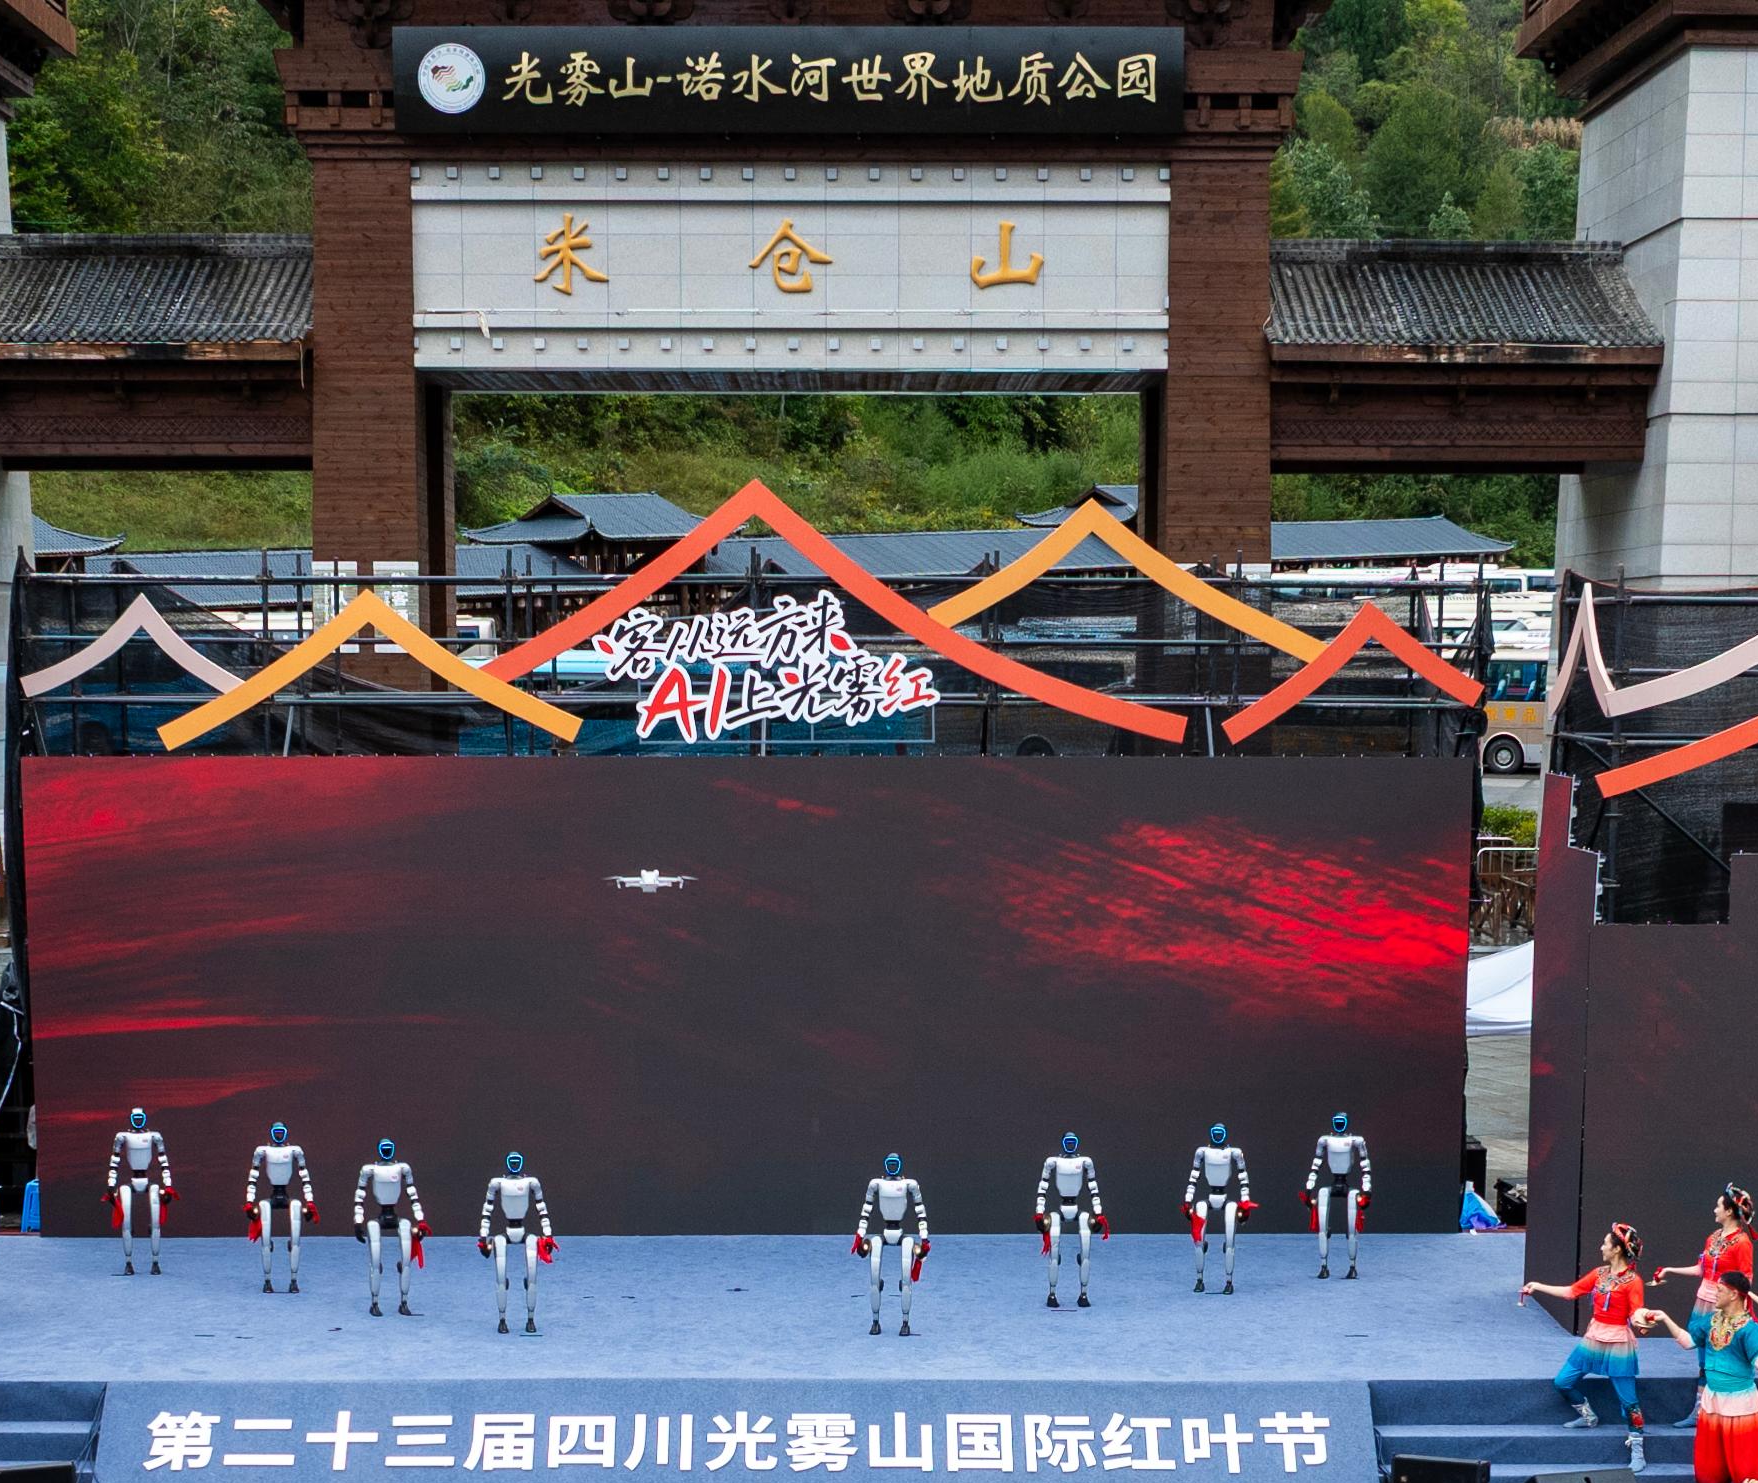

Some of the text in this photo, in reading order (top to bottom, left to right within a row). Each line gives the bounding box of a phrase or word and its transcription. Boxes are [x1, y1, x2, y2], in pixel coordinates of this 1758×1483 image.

[502, 51, 1159, 106] 光雾山-诺水河世界地质公园
[533, 213, 1045, 296] 米仓山
[611, 596, 841, 674] 客从远方来
[642, 651, 936, 740] AI上光雾红
[143, 1411, 1330, 1474] 第二十三届四川光雾山国际红叶节
